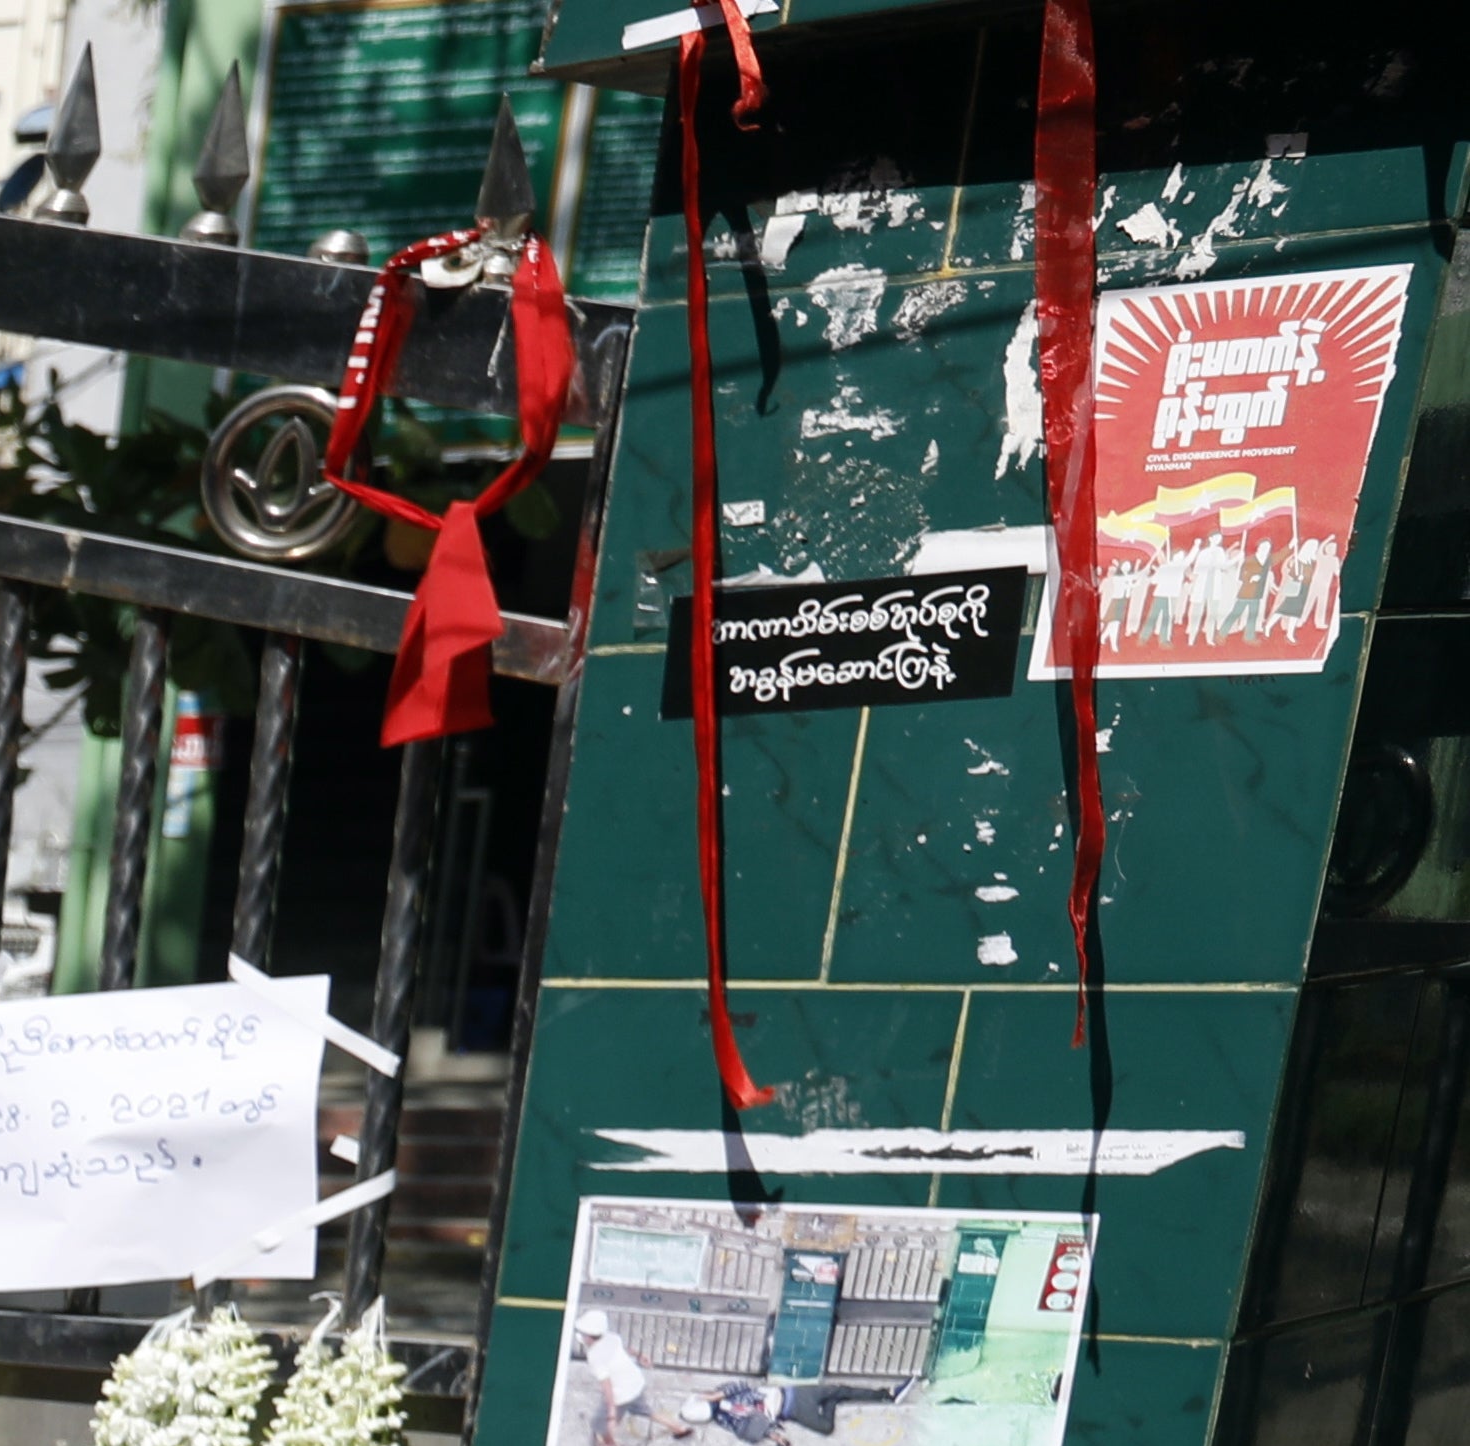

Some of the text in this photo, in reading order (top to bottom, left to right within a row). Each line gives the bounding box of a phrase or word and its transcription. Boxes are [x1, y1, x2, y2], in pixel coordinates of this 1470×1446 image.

[1147, 446, 1297, 463] CIVIL DISOBEDIENCE MOVEMENT
[1145, 461, 1192, 472] MYANMAR
